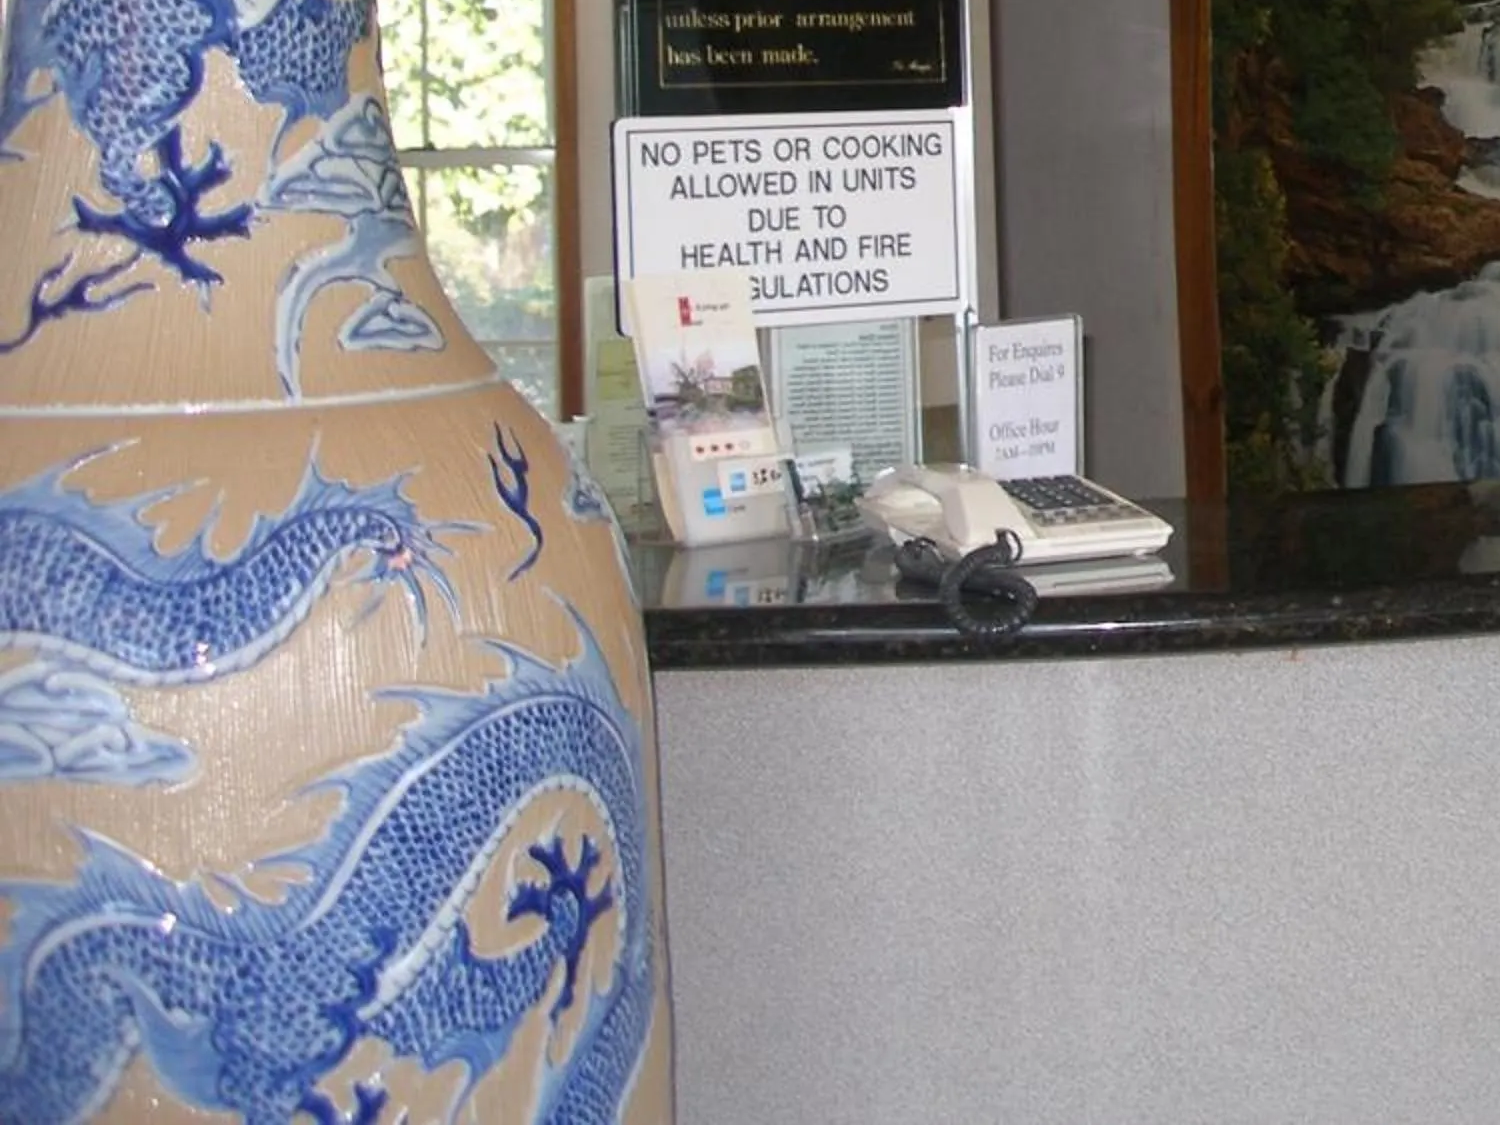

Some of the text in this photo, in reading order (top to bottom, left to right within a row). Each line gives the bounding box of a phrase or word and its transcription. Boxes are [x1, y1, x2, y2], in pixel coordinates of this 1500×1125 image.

[664, 7, 915, 32] unless prior arrangement
[667, 45, 701, 66] has
[706, 44, 753, 64] been
[641, 133, 942, 166] NO PETS OR COOKING
[670, 166, 917, 200] ALLOWED IN UNITS
[748, 204, 847, 233] DUE TO
[681, 233, 912, 269] HEALTH AND FIRE
[749, 269, 890, 301] GULATIONS
[988, 344, 1010, 363] For
[988, 370, 1026, 391] Please
[988, 421, 1026, 442] Office
